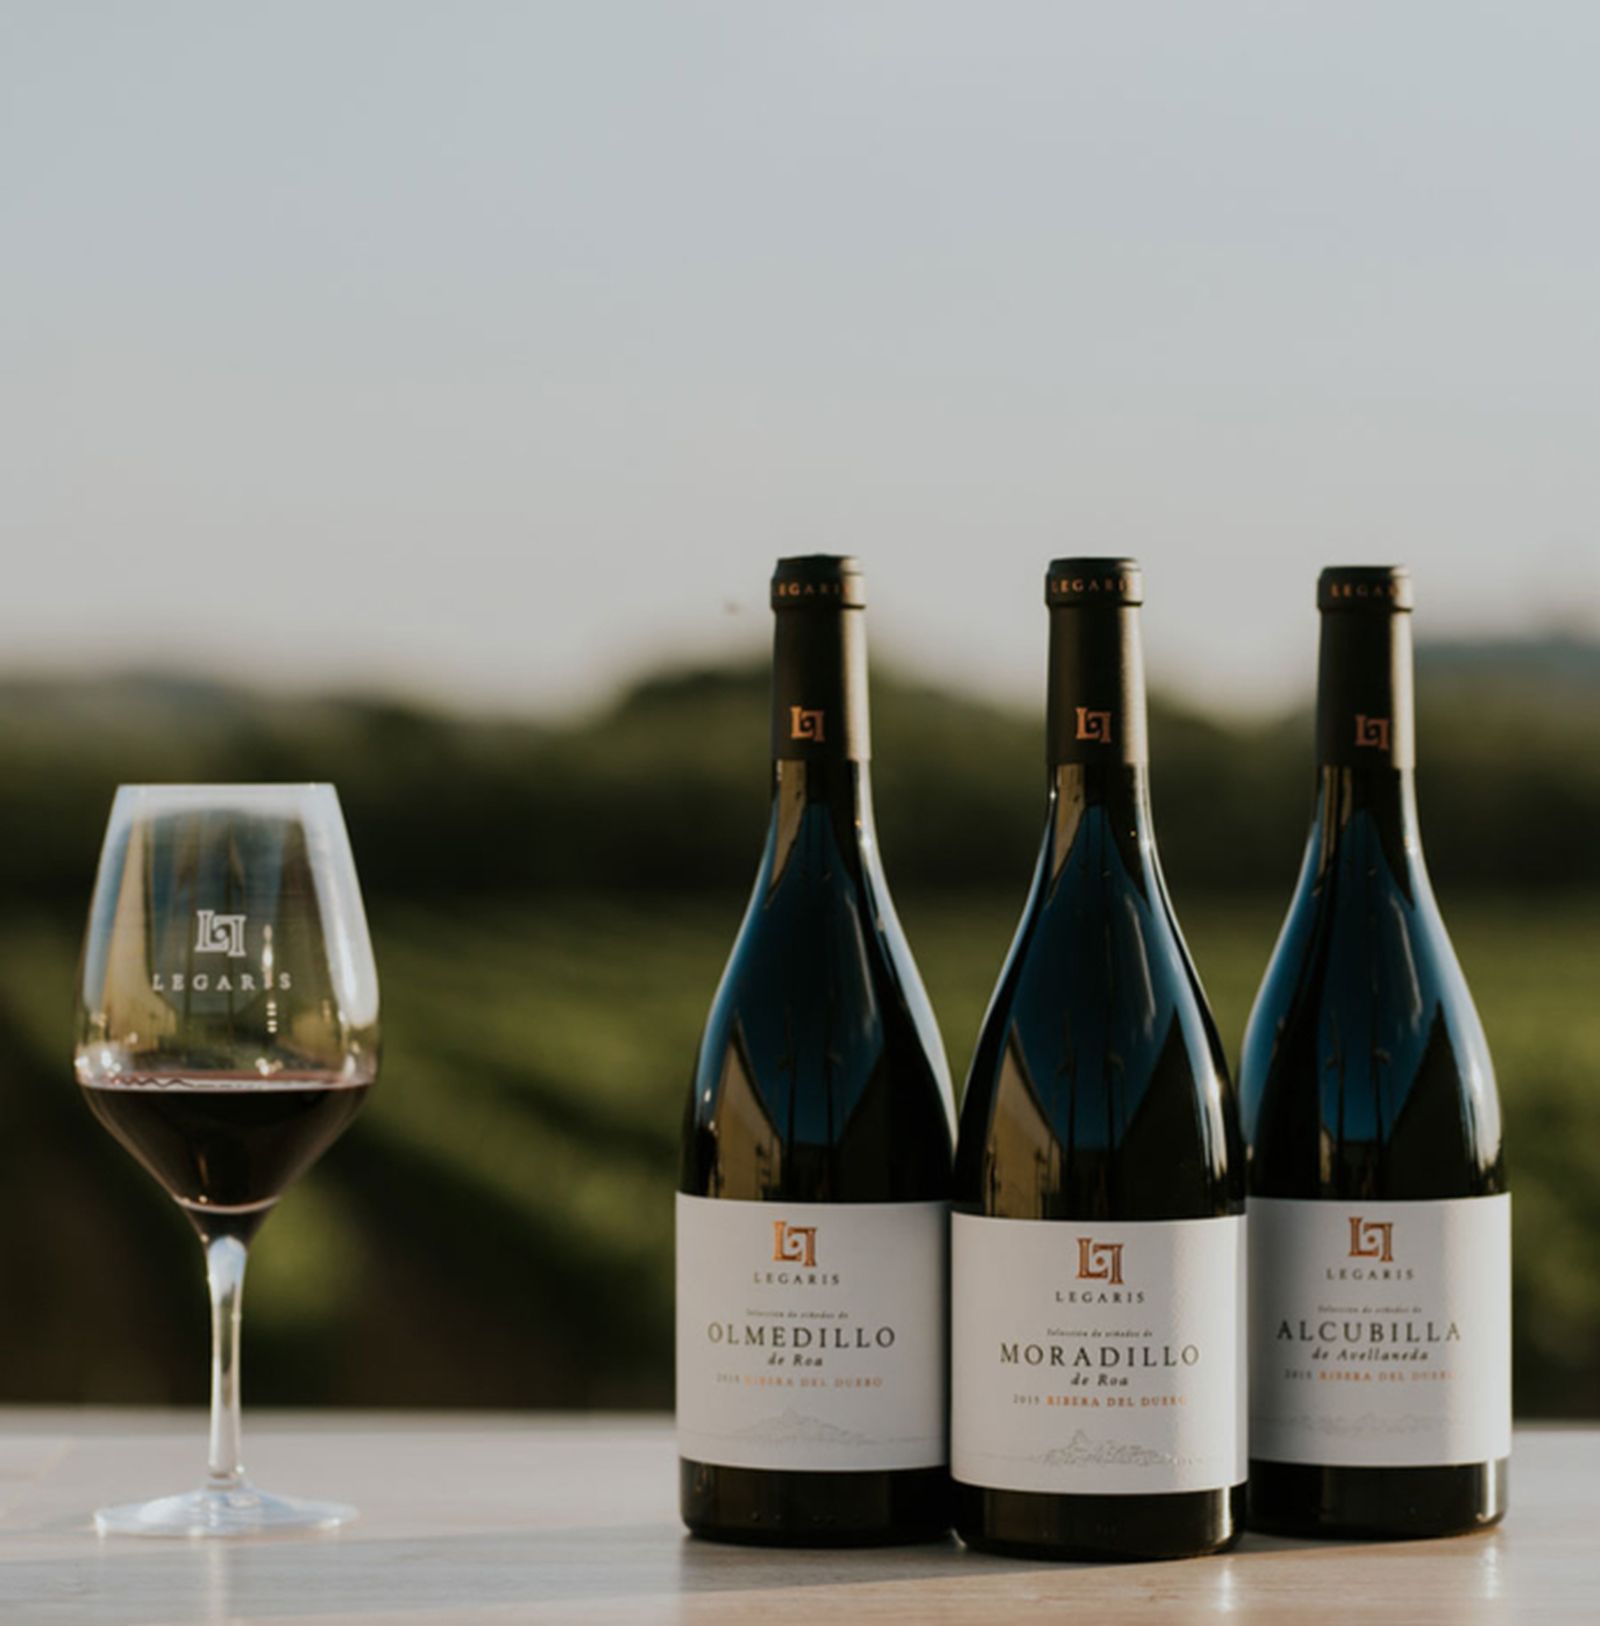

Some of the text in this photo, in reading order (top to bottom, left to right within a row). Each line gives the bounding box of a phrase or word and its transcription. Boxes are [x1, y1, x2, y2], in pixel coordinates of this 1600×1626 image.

[152, 972, 292, 991] LEGARIS
[753, 1272, 841, 1286] LEGARIS
[1326, 1268, 1415, 1281] LEGARIS
[1055, 1291, 1146, 1304] LEGARIS
[707, 1322, 896, 1348] OLMEDILLO
[1277, 1320, 1461, 1343] ALCUBILLA
[767, 1352, 824, 1367] de Roa
[1000, 1343, 1200, 1367] MORADILLO
[1311, 1347, 1429, 1361] de Avellaneda
[800, 1376, 827, 1388] DEL
[834, 1377, 884, 1389] DUERO
[1070, 1372, 1129, 1387] de Roa
[1317, 1370, 1371, 1382] RIBERA
[1378, 1371, 1404, 1382] DEL
[1045, 1395, 1101, 1407] RIBERA
[1106, 1395, 1135, 1408] DEL
